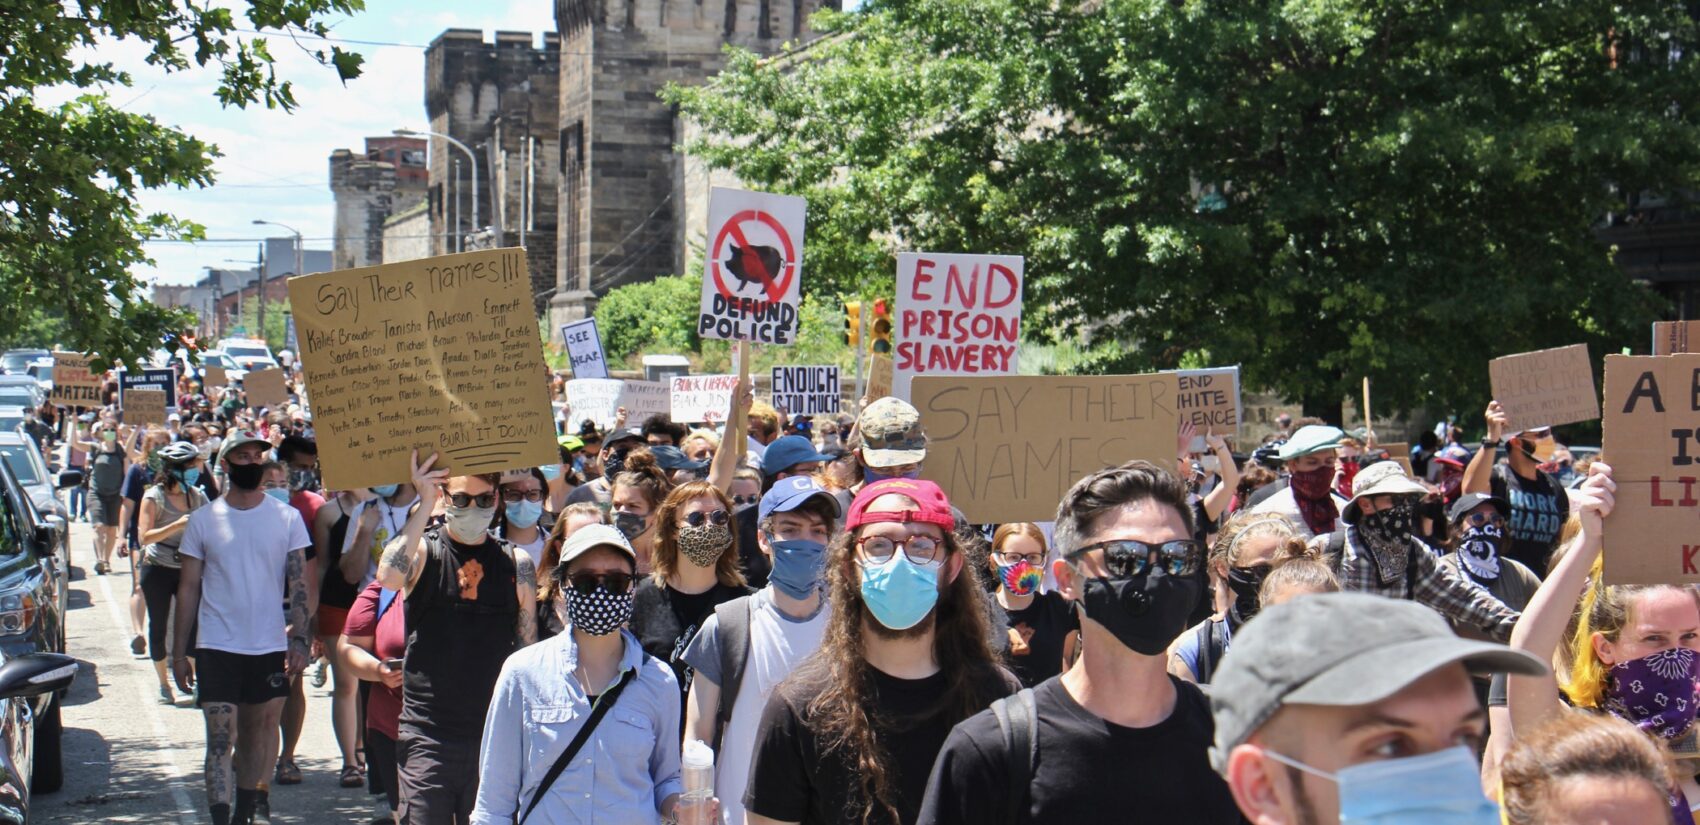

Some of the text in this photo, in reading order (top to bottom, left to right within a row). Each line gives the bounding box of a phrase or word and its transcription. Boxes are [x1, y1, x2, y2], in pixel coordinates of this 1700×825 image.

[912, 259, 1018, 309] END
[317, 284, 359, 323] Say
[713, 293, 794, 326] DEFUND
[307, 329, 336, 353] Kalief
[380, 319, 421, 339] Tanisha
[427, 311, 473, 330] Anderson
[484, 299, 520, 315] Emmett
[491, 316, 506, 328] Till
[701, 314, 791, 344] POLICE
[903, 309, 1018, 344] PRISON
[330, 350, 359, 365] Sandra
[363, 344, 385, 358] Bland
[433, 335, 457, 347] Brown
[568, 331, 589, 344] SEE
[474, 350, 496, 361] Diallo
[570, 351, 600, 368] HEAR
[897, 342, 1015, 372] SLAVERY
[53, 384, 101, 400] MATTER
[773, 367, 837, 393] ENOUGH
[1179, 375, 1213, 390] END
[1623, 371, 1665, 413] A
[469, 402, 478, 410] so
[485, 400, 503, 409] many
[773, 395, 839, 414] IS TOO MUCH
[928, 381, 1174, 441] SAY THEIR
[1177, 391, 1227, 409] HITE
[1180, 408, 1236, 425] LENCE
[440, 431, 470, 448] BURN
[476, 428, 491, 441] IT
[497, 423, 544, 438] DOWN!
[1672, 427, 1700, 466] I
[1509, 489, 1559, 513] WORK
[1509, 509, 1559, 533] HARD
